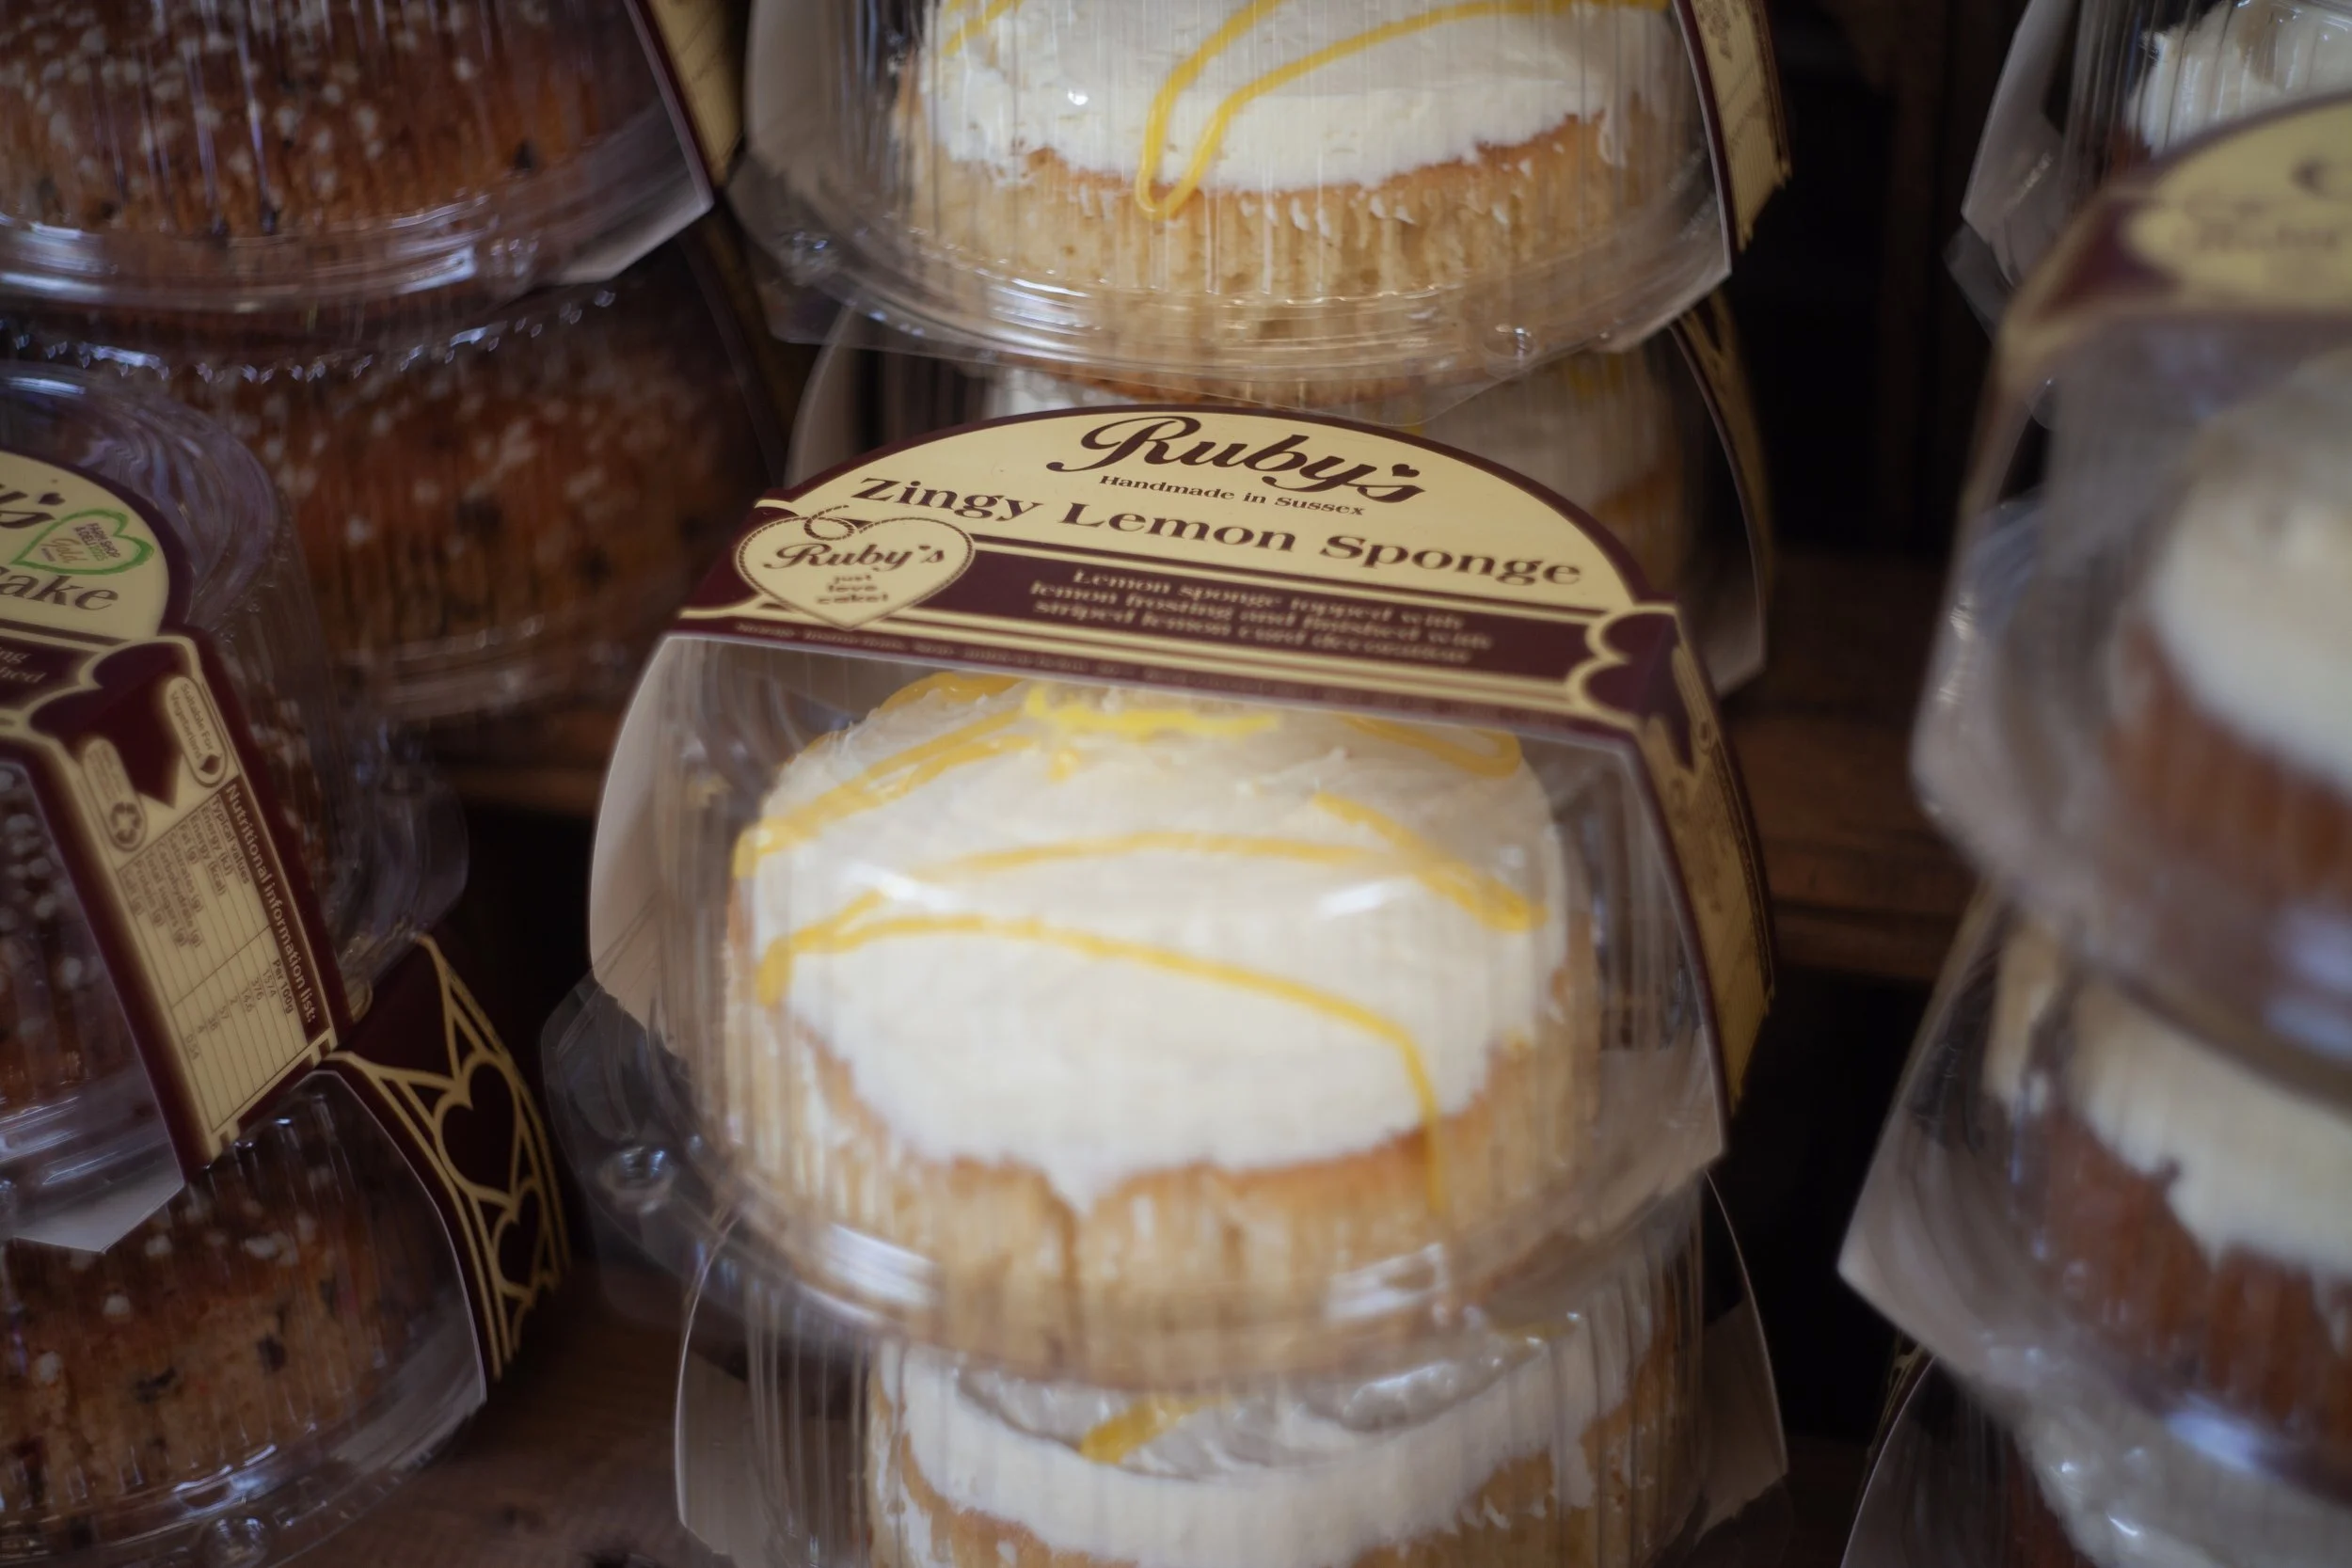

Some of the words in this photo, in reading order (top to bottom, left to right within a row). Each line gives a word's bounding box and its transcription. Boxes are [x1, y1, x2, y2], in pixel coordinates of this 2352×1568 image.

[1045, 416, 1425, 503] Ruby's
[1099, 475, 1234, 501] Handmade
[1244, 492, 1267, 505] in
[1275, 496, 1364, 515] Sussex
[850, 477, 1044, 521] Zingy
[1058, 502, 1296, 552] Lemon
[1319, 535, 1581, 585] Sponge
[763, 543, 945, 572] Ruby's
[1030, 581, 1118, 604] lemon
[1125, 593, 1233, 621] frosting
[1073, 570, 1170, 594] Lemon
[181, 682, 204, 733] Suitable
[201, 730, 215, 752] For
[179, 823, 192, 847] Fat
[199, 804, 225, 853] Energy
[210, 796, 235, 843] Typical
[230, 843, 251, 885] values
[185, 846, 200, 866] (g)
[186, 815, 213, 863] Energy
[207, 861, 227, 896] (kcal)
[225, 784, 273, 883] Nutritional
[263, 882, 306, 990] information
[300, 988, 316, 1022] list:
[273, 958, 284, 982] Per
[278, 980, 296, 1014] 100g
